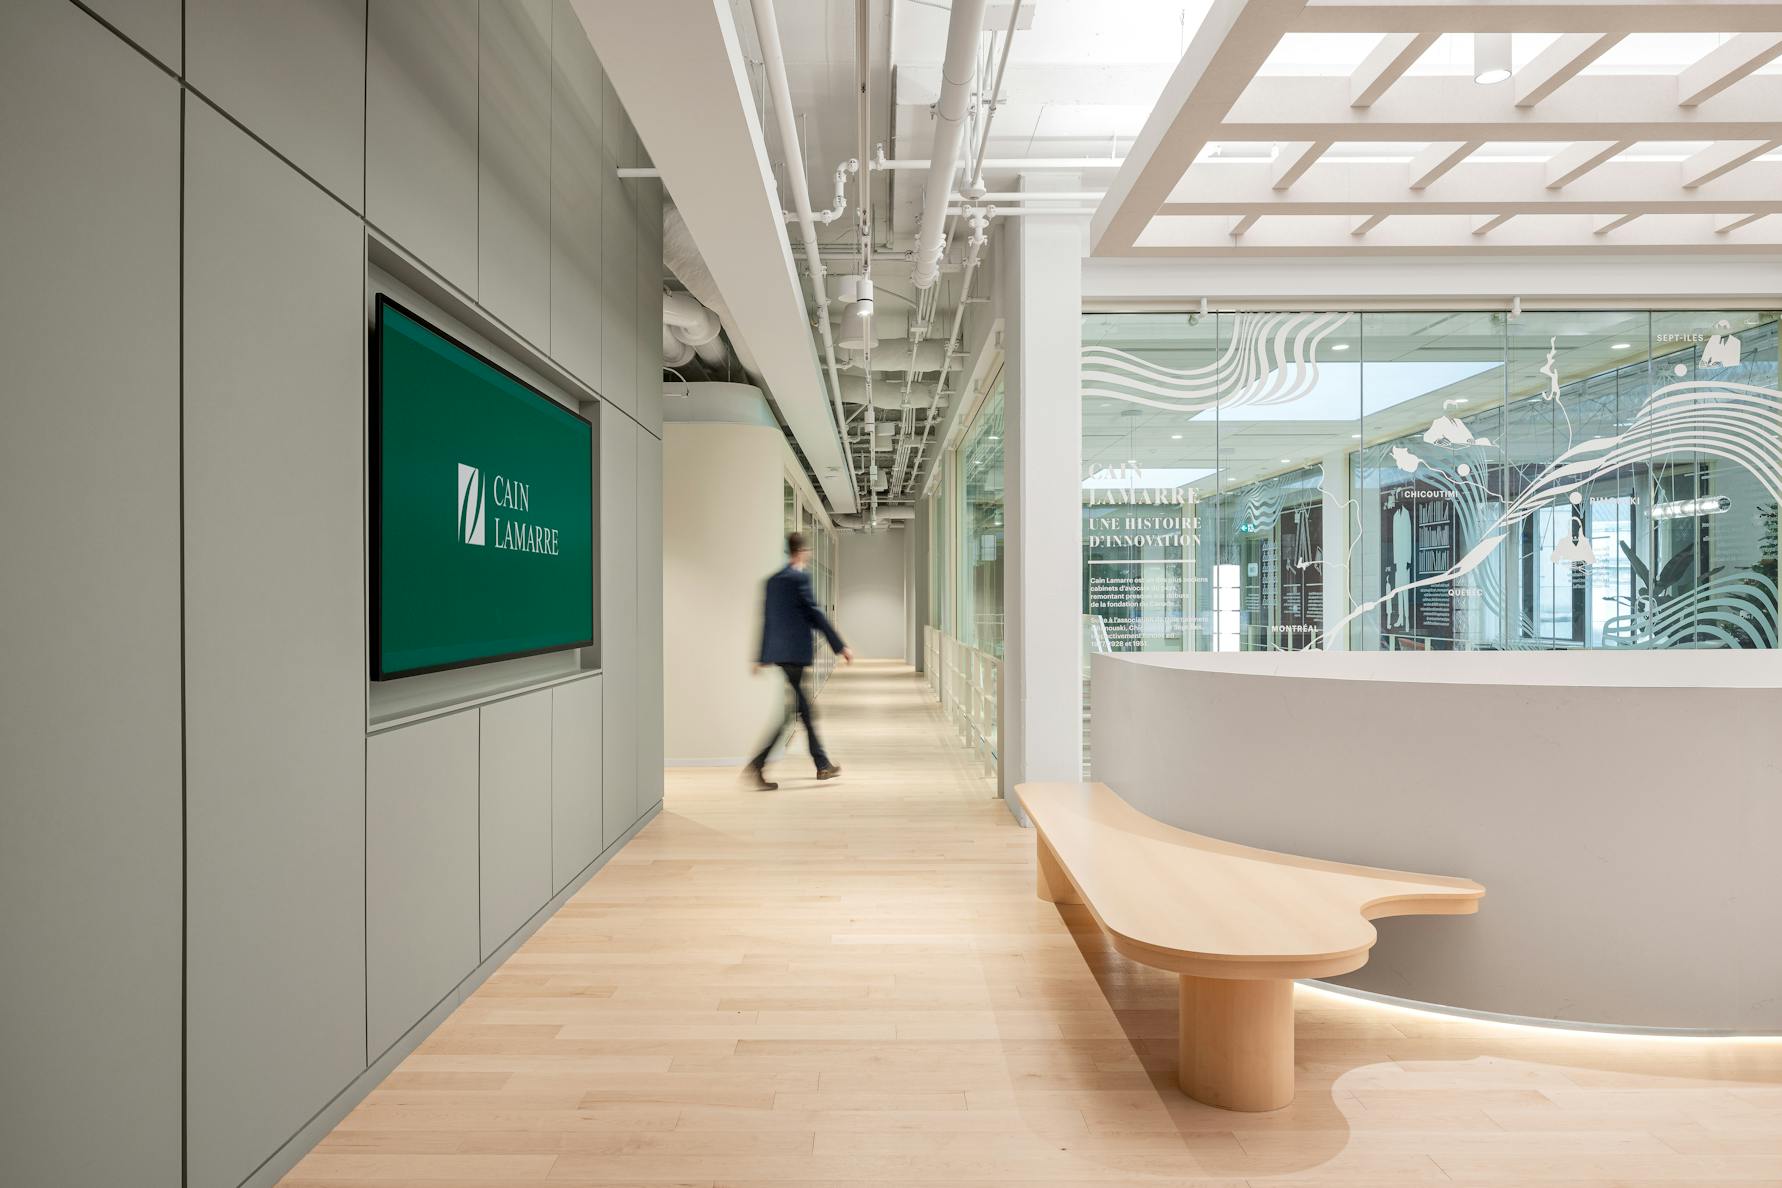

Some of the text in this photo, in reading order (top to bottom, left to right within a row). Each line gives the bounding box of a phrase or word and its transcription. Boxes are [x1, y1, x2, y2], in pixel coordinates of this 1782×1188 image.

[1088, 463, 1143, 480] CAIN
[493, 475, 529, 512] CAIN
[1088, 487, 1200, 504] LAMARRE
[1404, 490, 1458, 498] CHICOUTIMI
[1089, 517, 1202, 530] UNE HISTOIRE
[494, 517, 559, 555] LAMARRE
[1089, 534, 1200, 547] D'INNOVATION
[1271, 624, 1319, 633] MONTRÉAL
